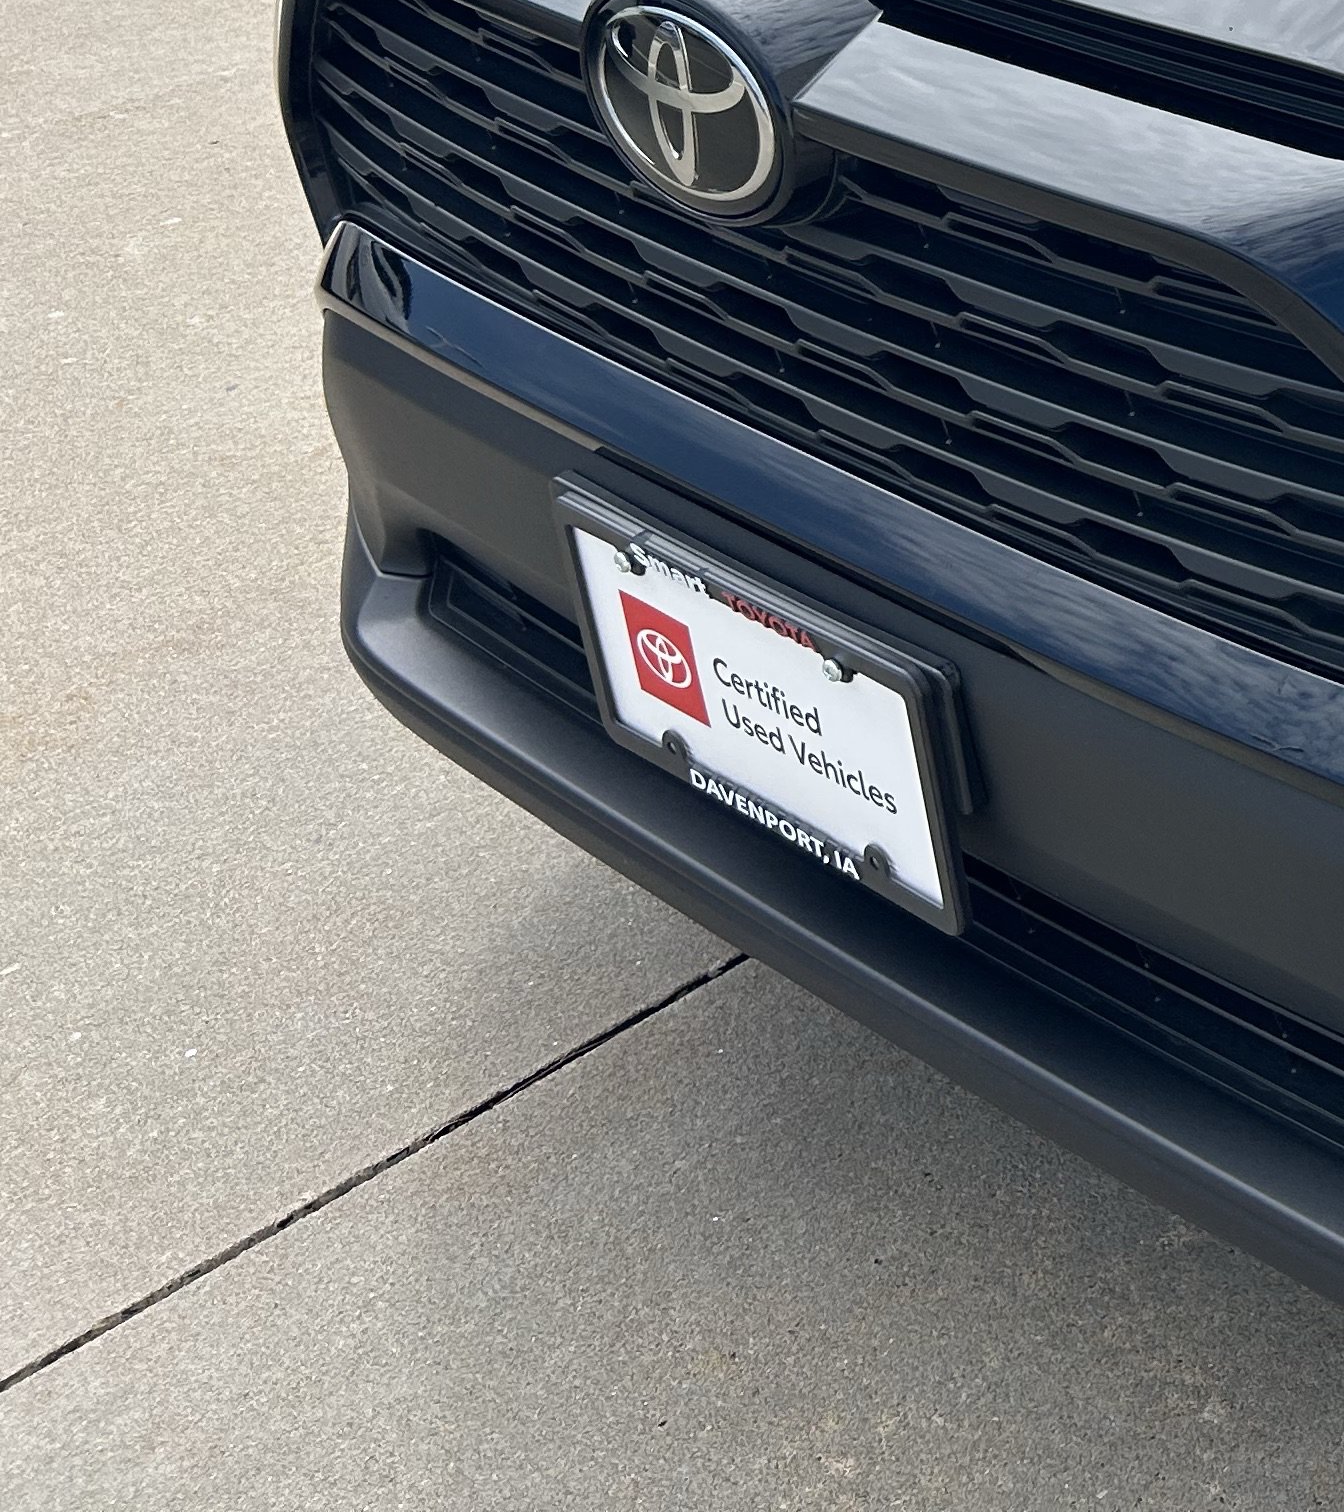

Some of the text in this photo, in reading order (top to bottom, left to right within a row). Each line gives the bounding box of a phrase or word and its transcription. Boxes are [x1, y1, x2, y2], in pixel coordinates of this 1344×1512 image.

[630, 542, 817, 653] Smart TOYOTA
[713, 657, 822, 736] Certified
[722, 699, 898, 816] Used Vehicles
[689, 769, 860, 881] DAVENPORT, IA
